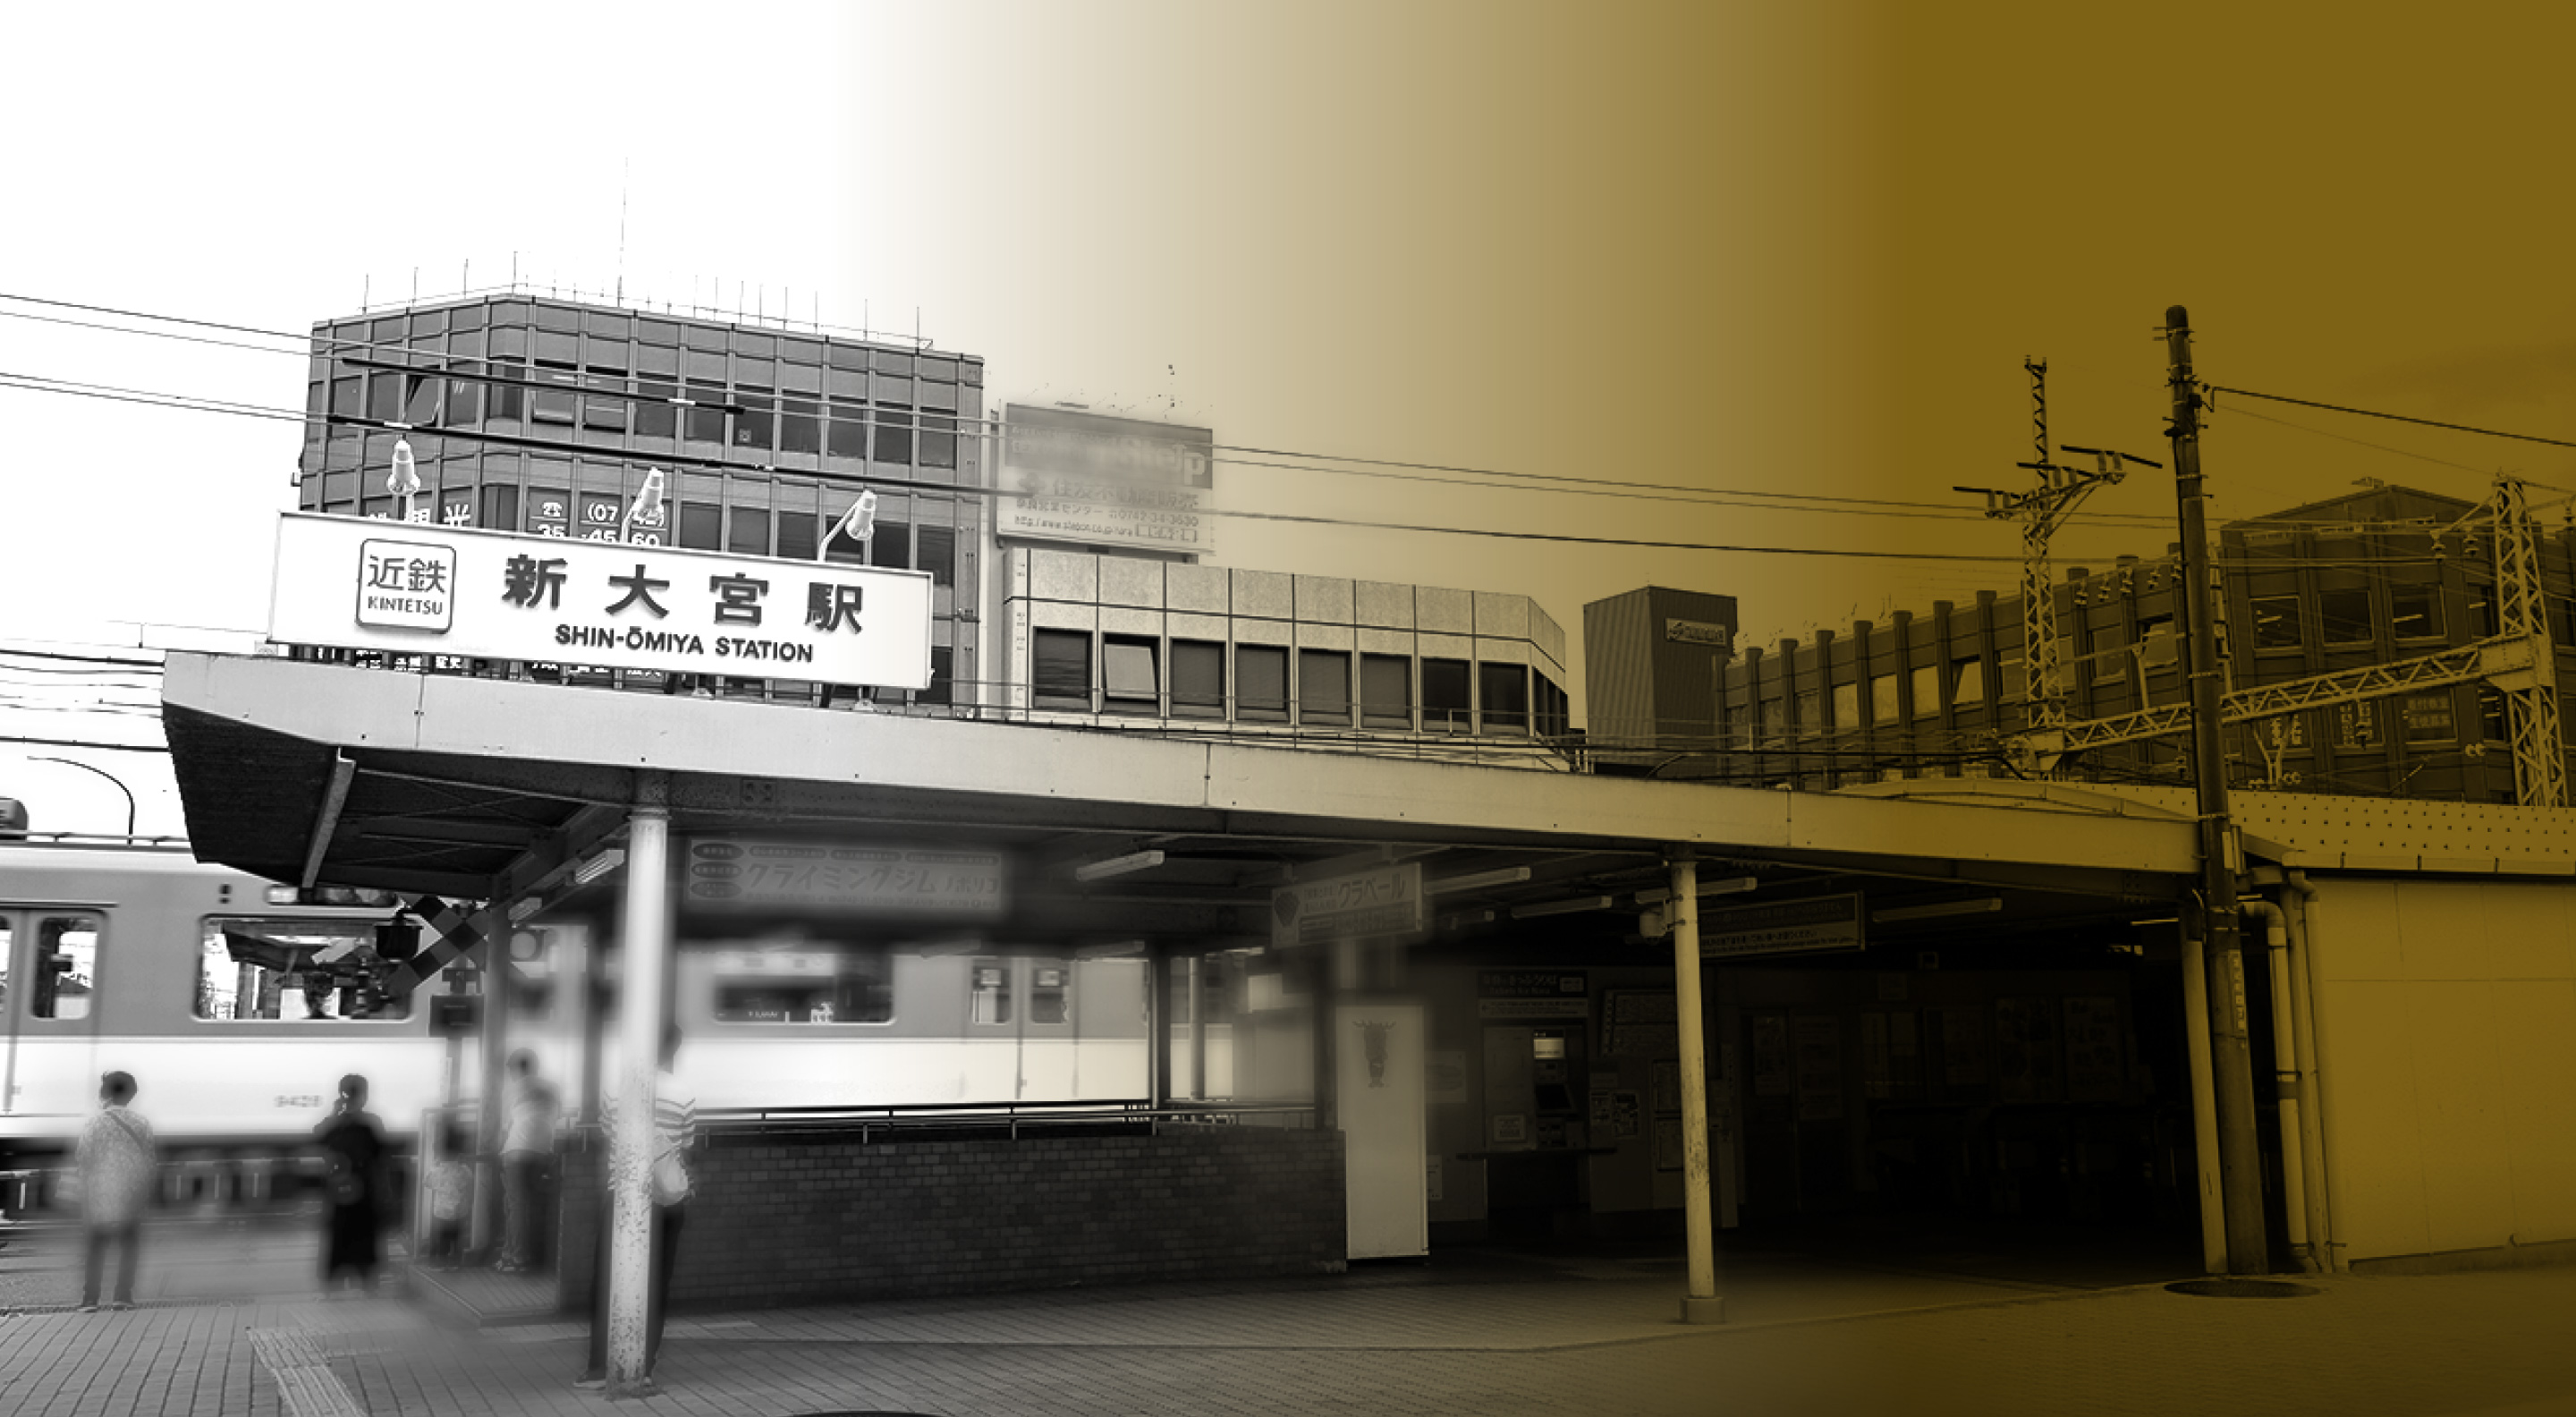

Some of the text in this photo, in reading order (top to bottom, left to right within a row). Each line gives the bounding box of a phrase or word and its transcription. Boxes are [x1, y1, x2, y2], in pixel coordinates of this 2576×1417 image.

[368, 555, 446, 594] 近鉄
[501, 553, 864, 634] 新大宮駅
[368, 596, 443, 615] KINTETSU
[555, 624, 814, 663] SHIN-ŌMIYA STATION
[746, 862, 936, 893] クライミングジム
